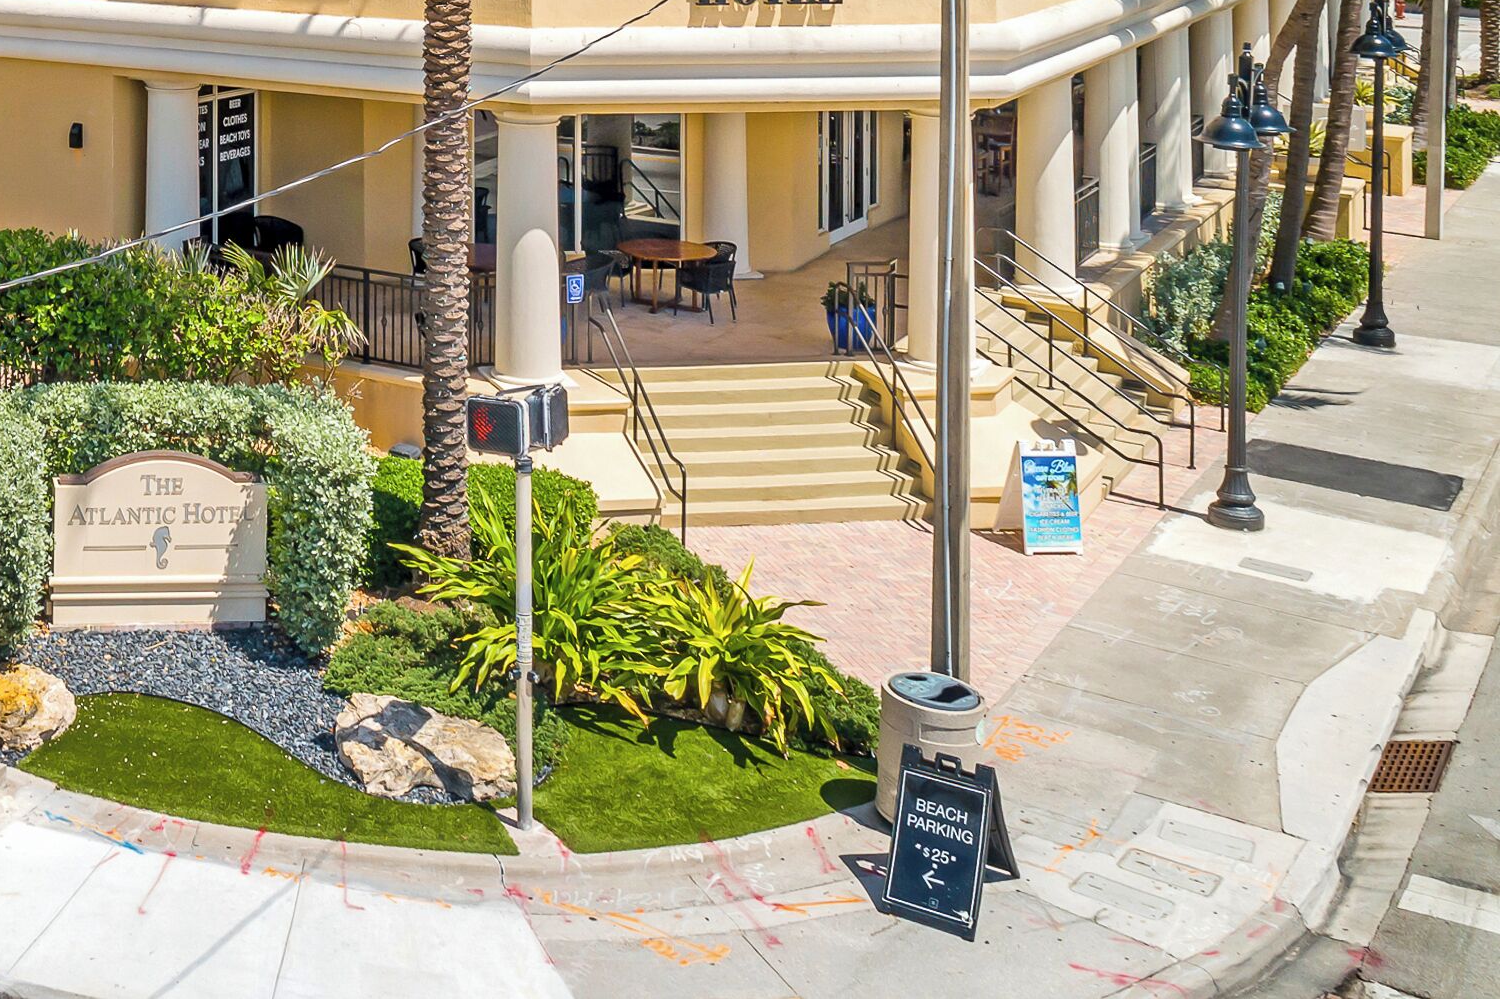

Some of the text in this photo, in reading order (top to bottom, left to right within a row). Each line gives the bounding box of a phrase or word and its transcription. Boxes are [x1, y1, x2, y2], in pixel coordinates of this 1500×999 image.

[229, 99, 242, 109] BEER
[223, 113, 248, 127] CLOTHES
[220, 132, 238, 145] BEACH
[238, 129, 251, 140] TOYS
[220, 146, 251, 162] BEVERAGES
[140, 474, 185, 496] THE
[67, 502, 255, 526] ATLANTIC HOTEL
[916, 798, 968, 825] BEACH
[906, 813, 974, 845] PARKING
